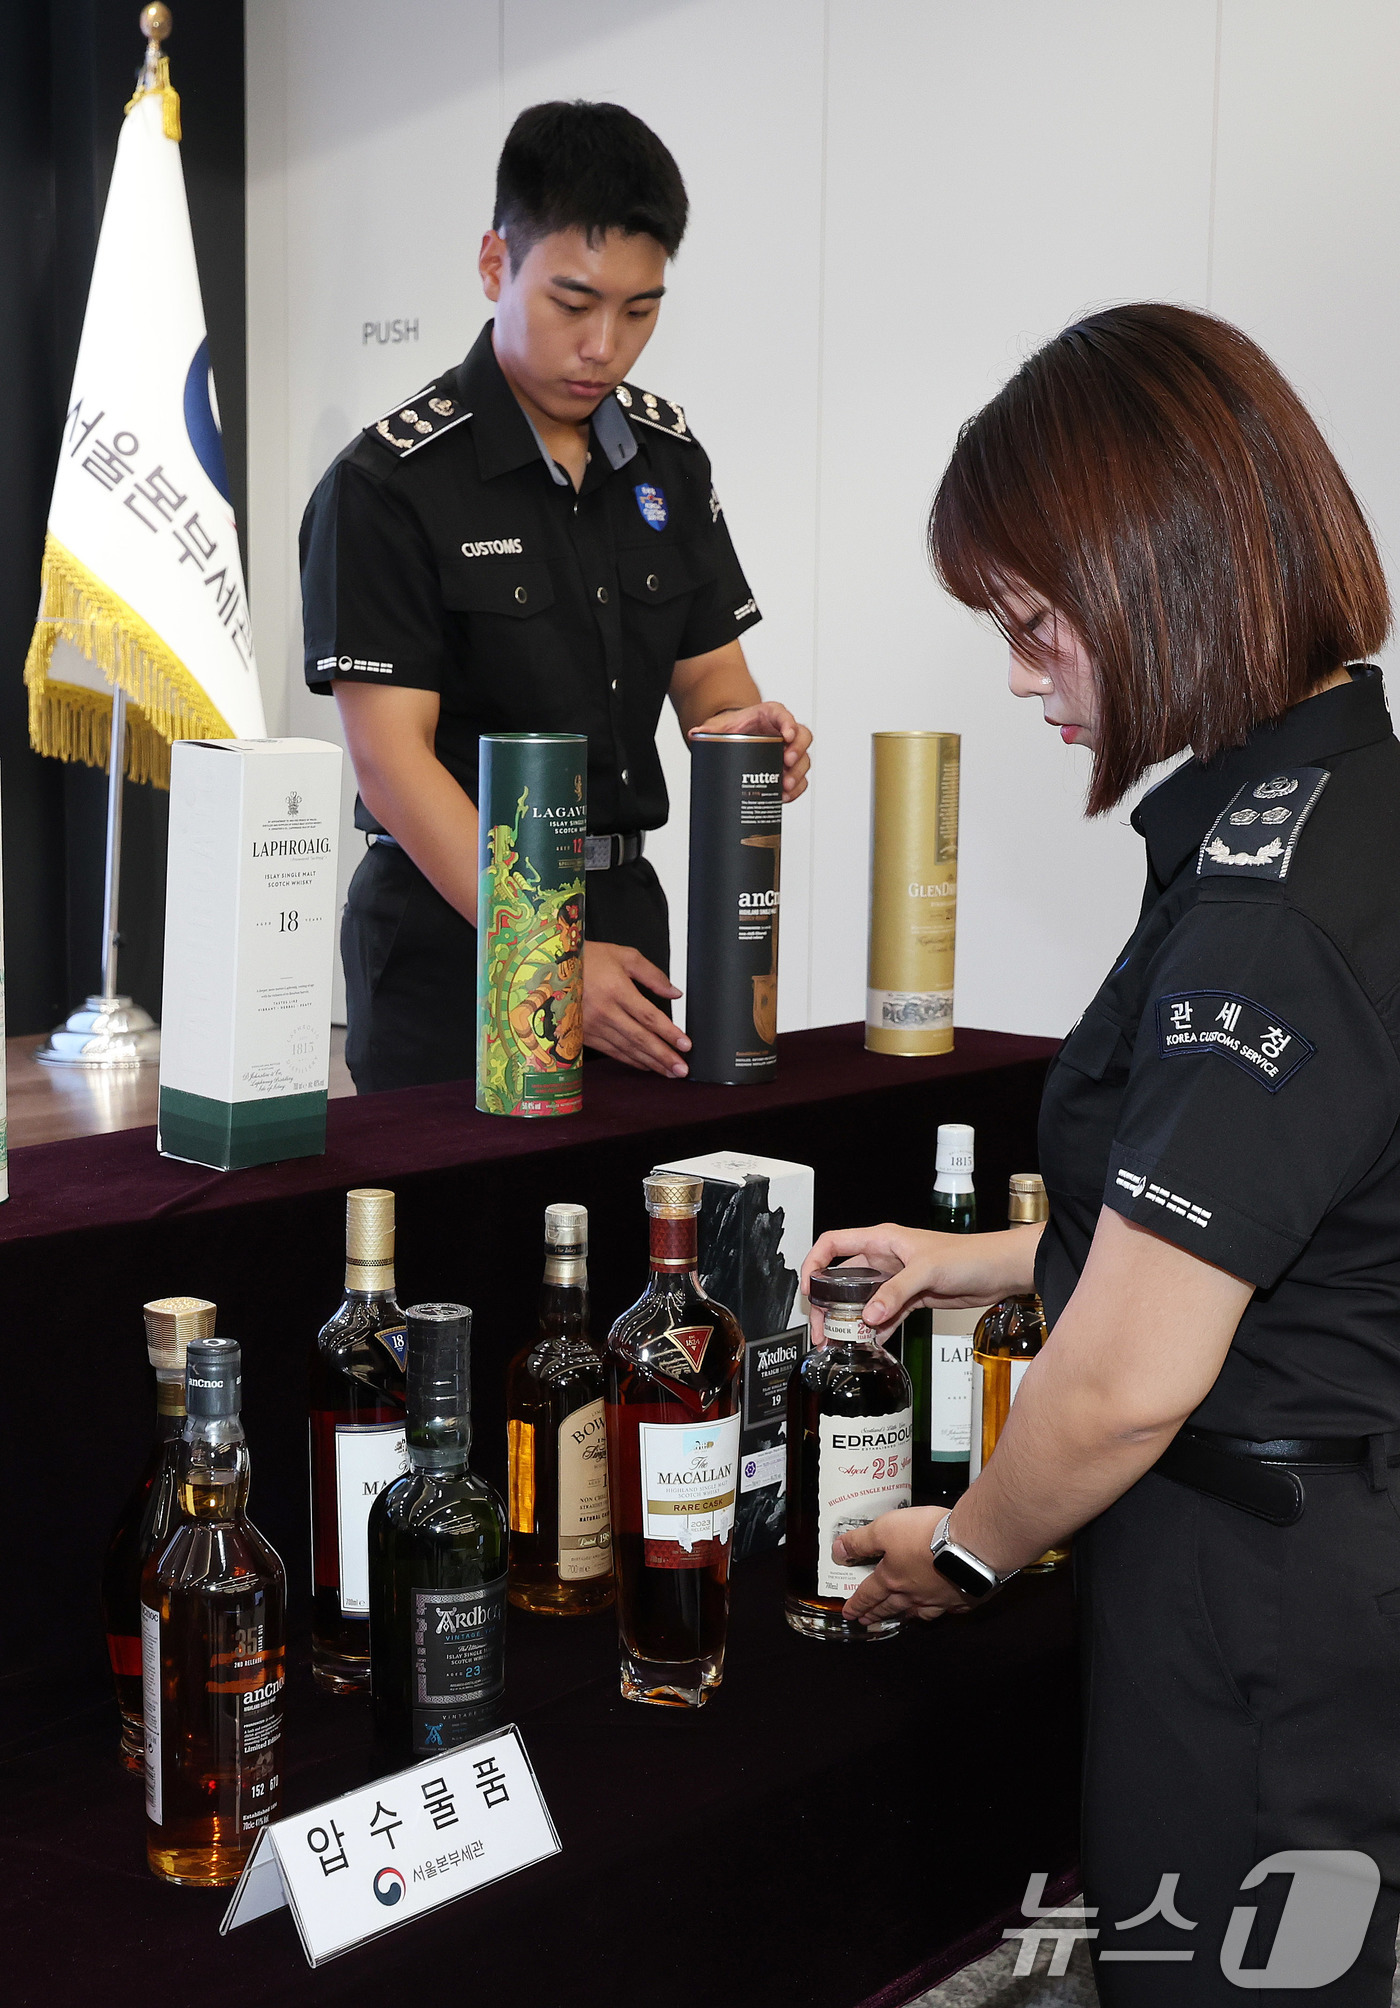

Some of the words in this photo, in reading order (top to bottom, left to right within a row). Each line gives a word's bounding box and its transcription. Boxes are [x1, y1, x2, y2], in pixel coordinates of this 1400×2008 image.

[362, 319, 419, 345] PUSH
[461, 538, 523, 558] CUSTOMS
[742, 772, 780, 784] rutter
[572, 838, 584, 853] 12
[278, 910, 299, 932] 18
[1166, 1032, 1198, 1046] KOREA
[1199, 1031, 1241, 1050] CUSTOMS
[1239, 1045, 1280, 1078] SERVICE
[951, 1156, 972, 1166] 1815
[391, 1334, 404, 1348] 18
[772, 1394, 781, 1406] 19
[689, 1456, 709, 1470] The
[872, 1455, 898, 1480] 25
[657, 1462, 732, 1485] MACALLAN
[828, 1492, 859, 1507] HIGHLAND
[860, 1487, 880, 1496] SINGLE
[673, 1503, 700, 1511] RARE
[703, 1499, 723, 1509] CASK
[690, 1519, 711, 1527] 2023
[235, 1627, 257, 1658] 35
[466, 1665, 481, 1678] 23
[252, 1783, 265, 1798] 152
[413, 1840, 485, 1883] 서울본부세관
